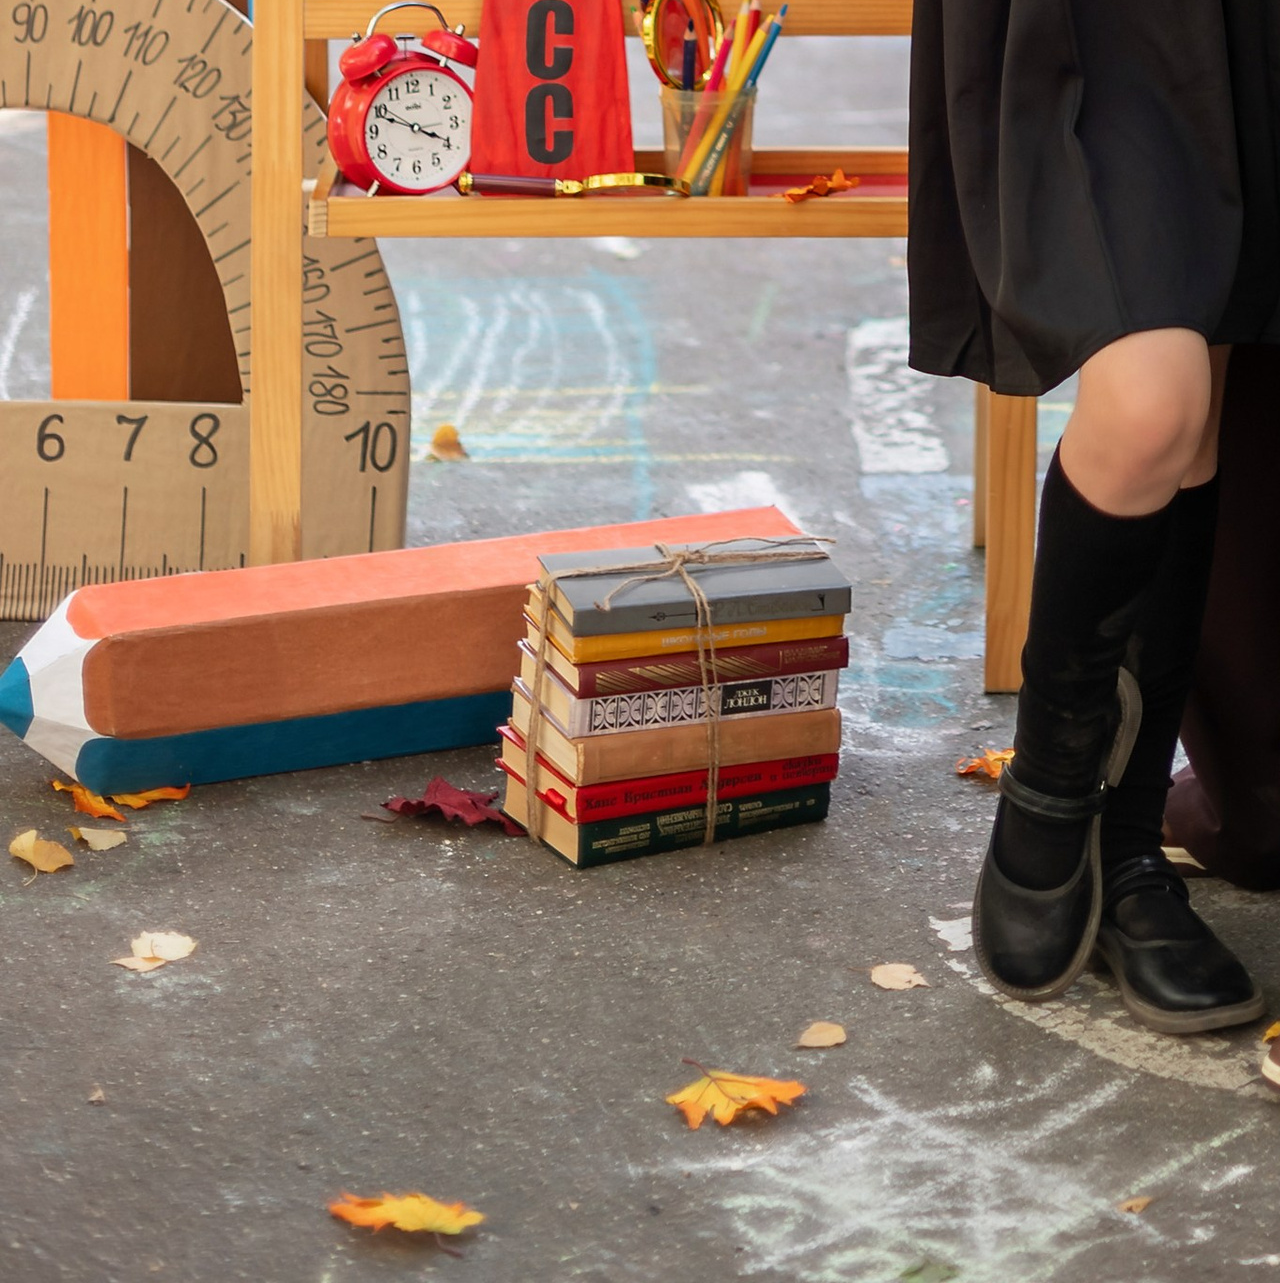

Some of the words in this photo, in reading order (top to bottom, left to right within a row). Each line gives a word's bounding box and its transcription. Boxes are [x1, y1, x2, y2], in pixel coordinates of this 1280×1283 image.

[12, 2, 49, 43] 90
[67, 4, 115, 47] 100
[123, 21, 170, 66] 110
[177, 53, 222, 99] 120
[388, 87, 400, 101] 11
[405, 79, 420, 94] 12
[429, 83, 435, 96] 1
[442, 95, 452, 110] 2
[374, 103, 388, 119] 10
[449, 115, 459, 130] 3
[369, 124, 379, 140] 9
[377, 143, 388, 159] 8
[442, 136, 452, 150] 4
[393, 157, 402, 173] 7
[412, 160, 422, 174] 6
[431, 152, 441, 167] 5
[303, 309, 344, 358] 170
[308, 365, 350, 416] 180
[36, 413, 65, 462] 6
[115, 413, 149, 463] 7
[188, 413, 222, 469] 8
[344, 420, 399, 474] 10
[733, 686, 760, 698] ДЖЕК
[724, 693, 767, 710] ЛОНДОН
